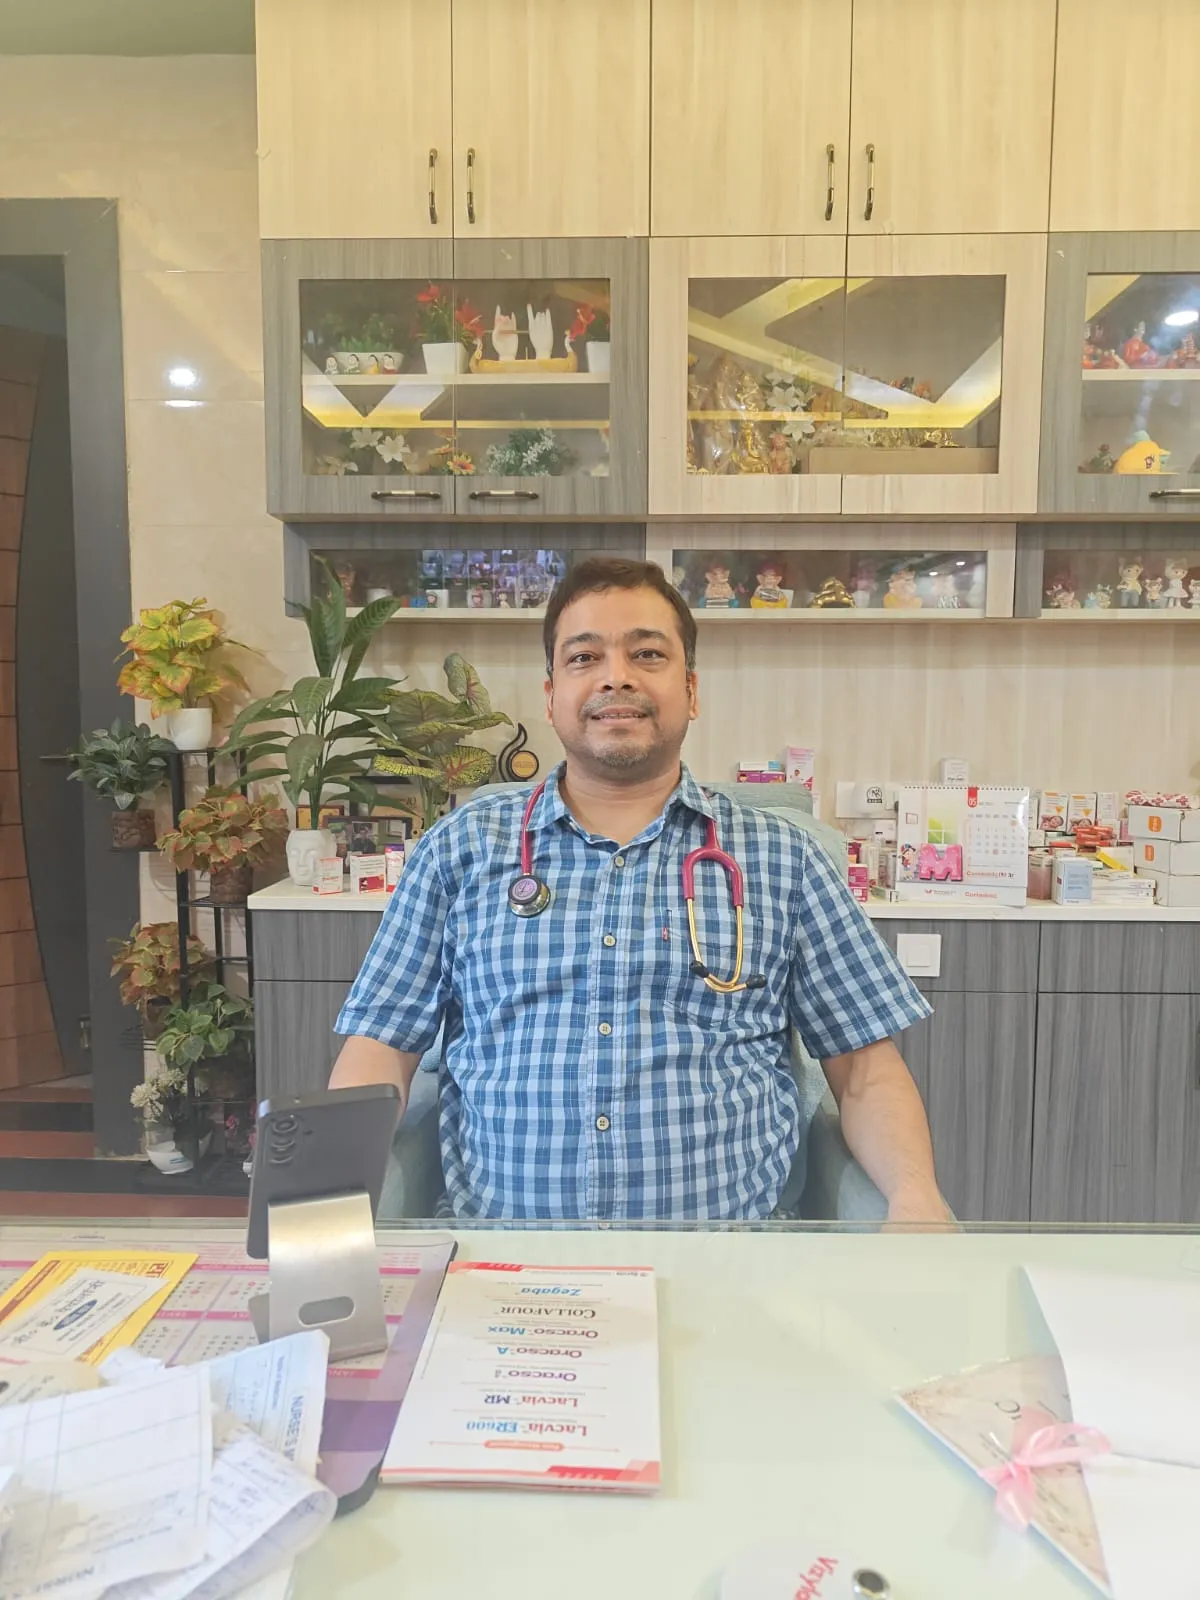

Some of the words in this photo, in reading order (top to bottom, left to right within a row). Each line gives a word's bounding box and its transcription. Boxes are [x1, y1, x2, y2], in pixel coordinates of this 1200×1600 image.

[968, 798, 977, 807] 05
[919, 843, 963, 882] M
[521, 1287, 581, 1297] Zegaba
[501, 1307, 596, 1319] COLLAFOUR
[508, 1370, 577, 1382] Oracso
